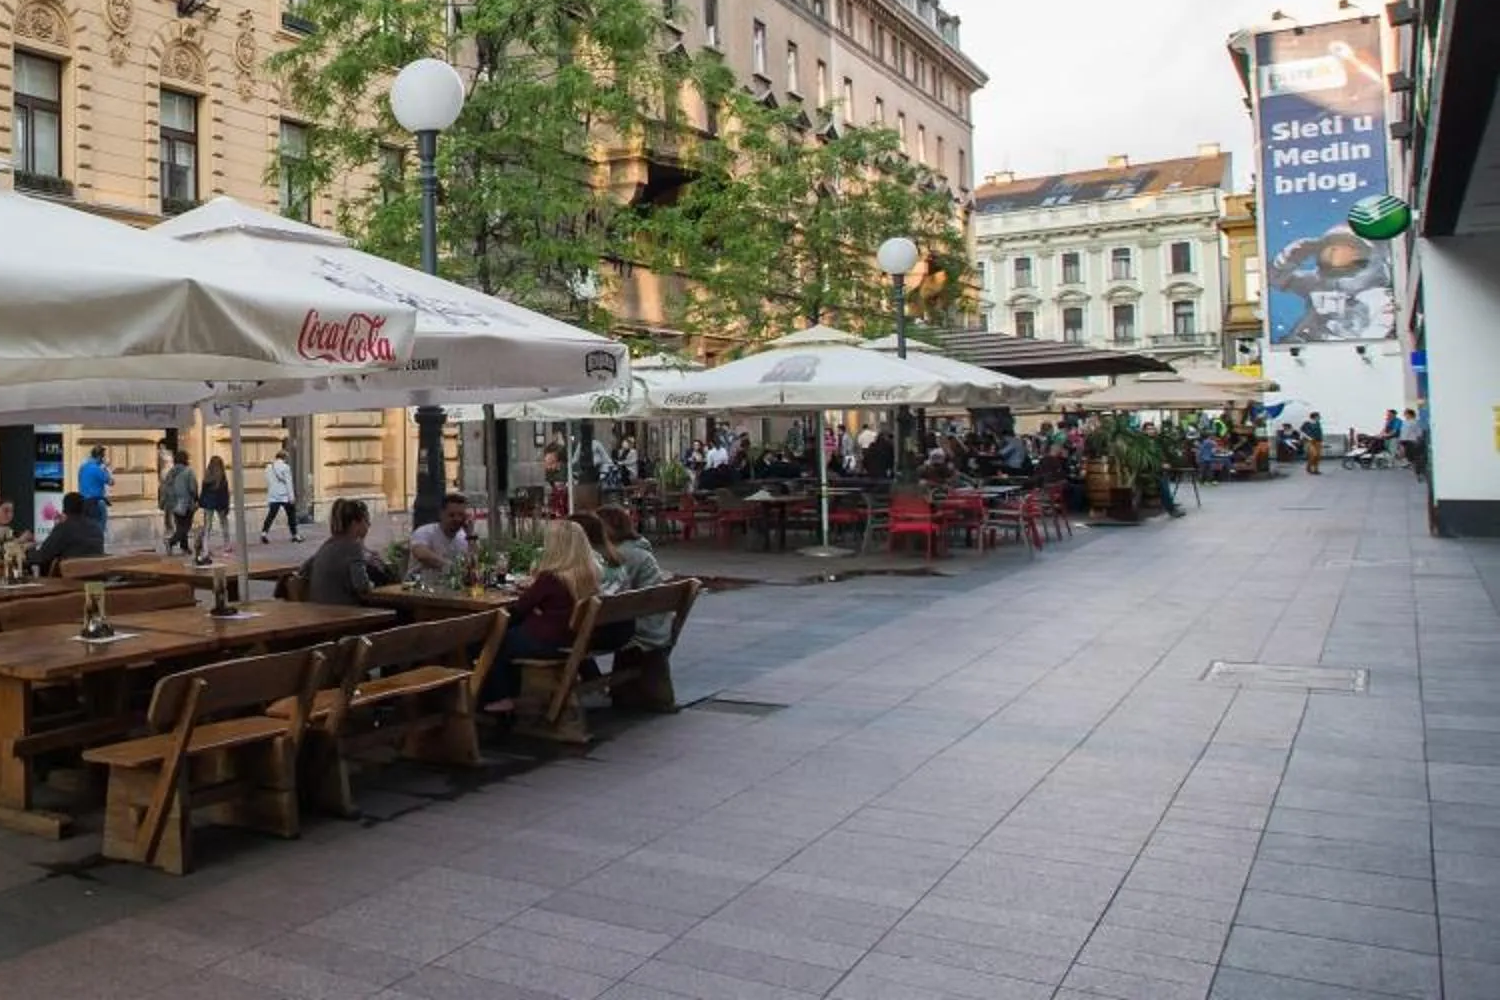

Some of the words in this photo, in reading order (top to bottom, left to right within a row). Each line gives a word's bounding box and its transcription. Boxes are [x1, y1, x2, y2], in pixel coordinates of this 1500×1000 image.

[1272, 115, 1343, 141] Sleti
[1353, 115, 1373, 132] u
[1273, 141, 1372, 168] Medin
[1274, 171, 1368, 195] brlog.
